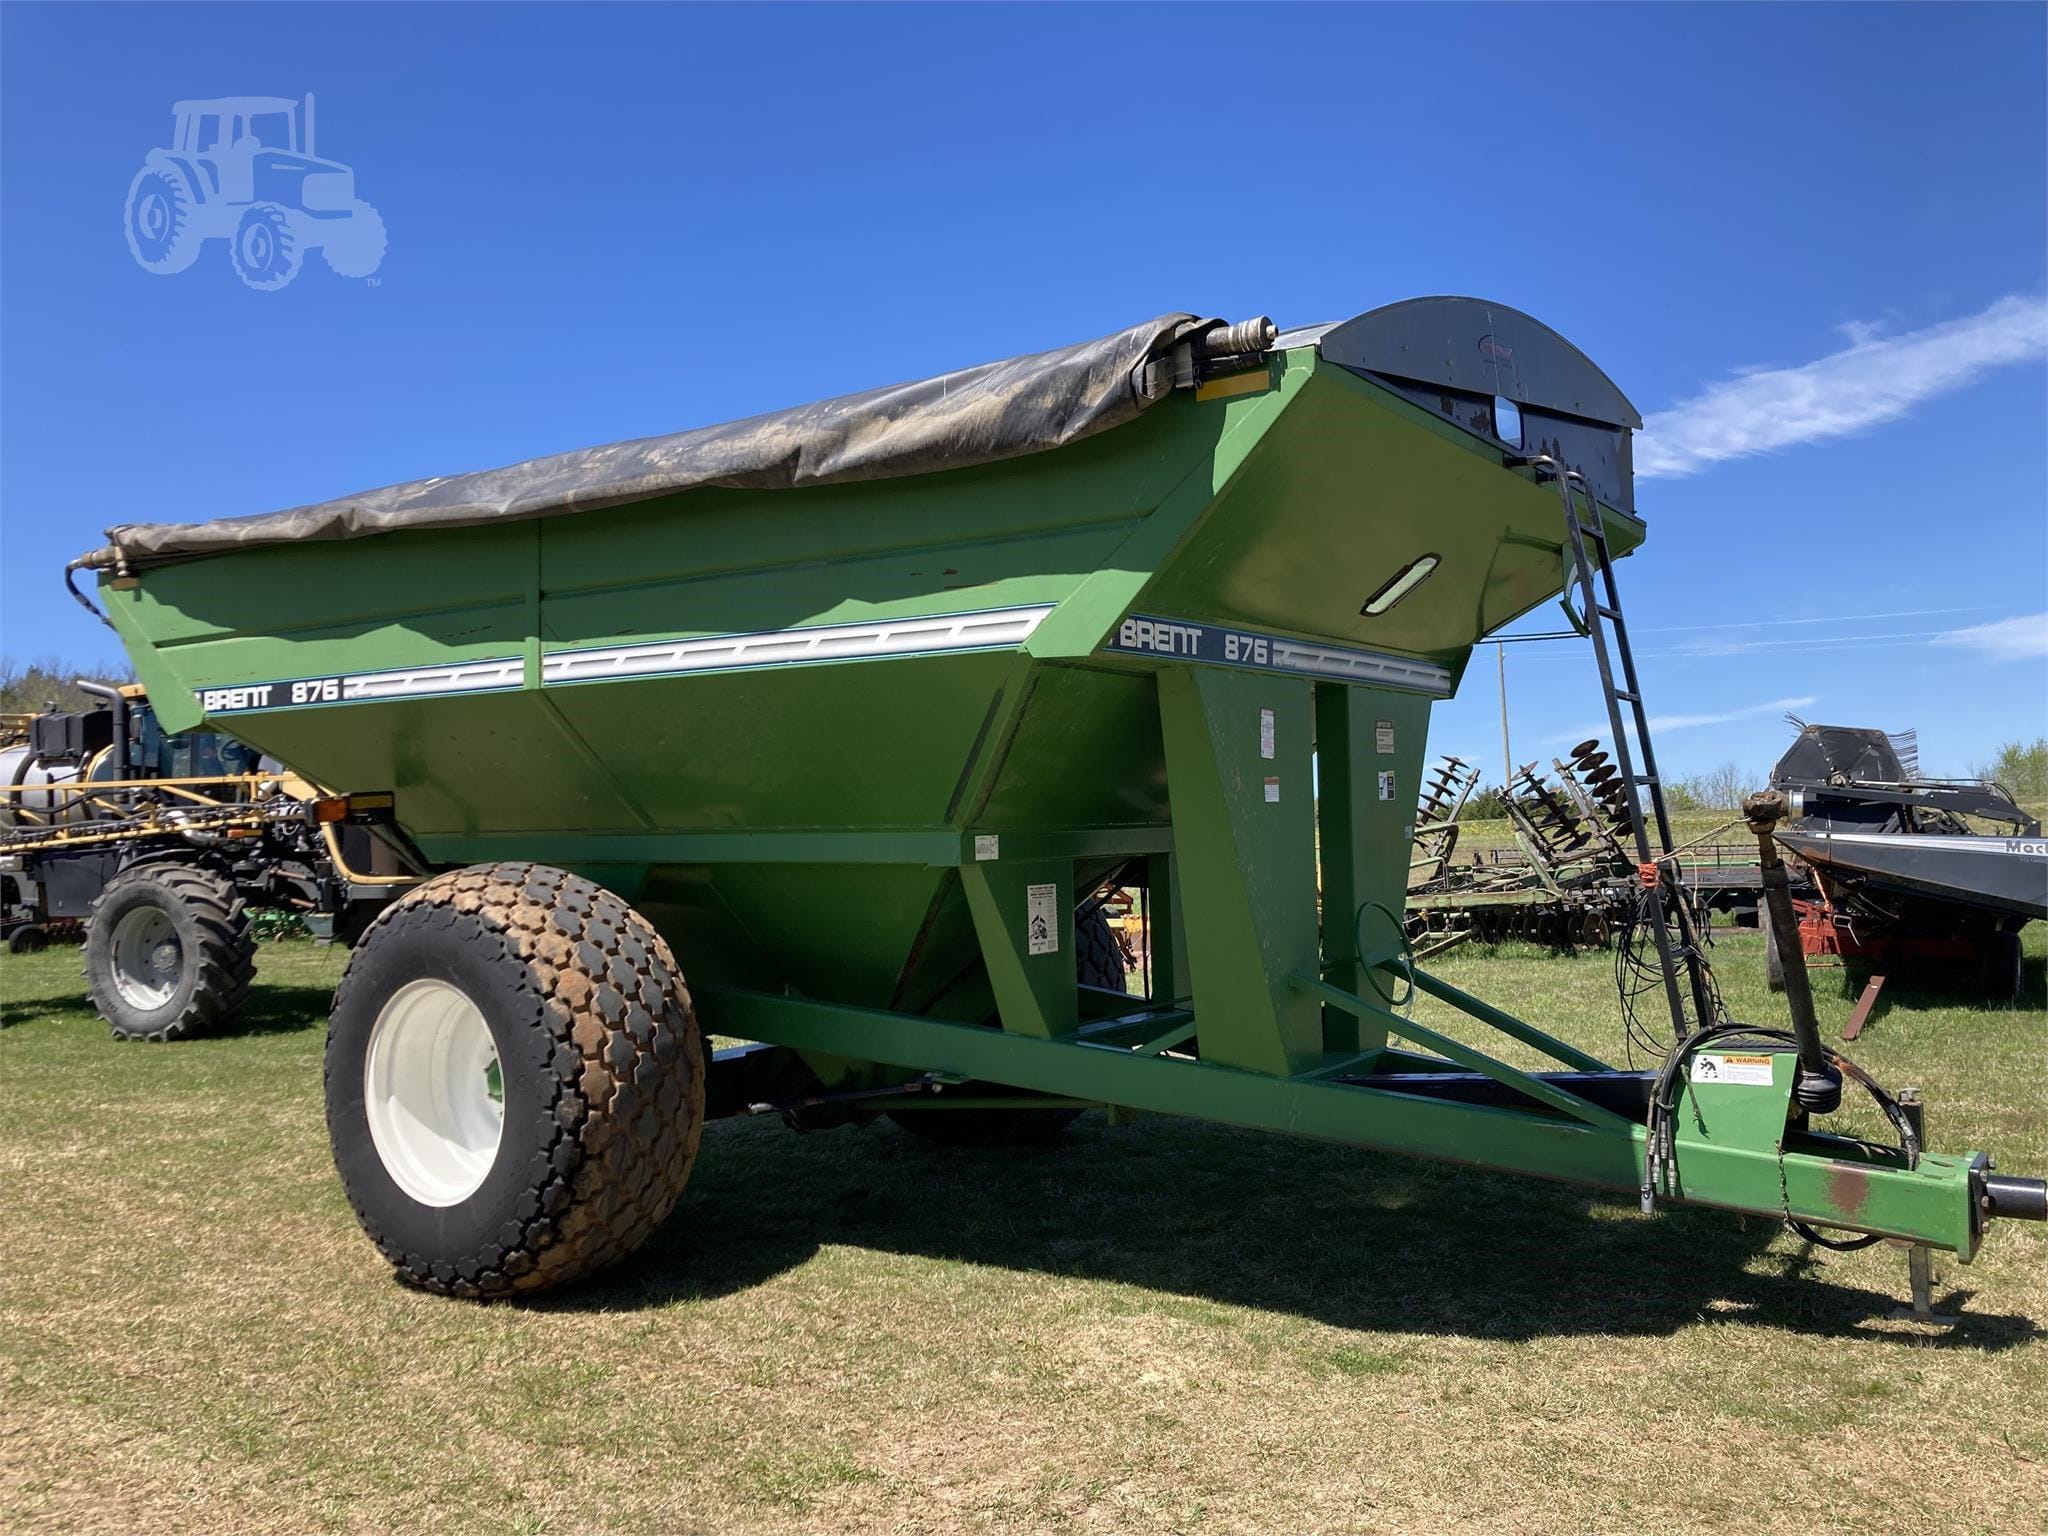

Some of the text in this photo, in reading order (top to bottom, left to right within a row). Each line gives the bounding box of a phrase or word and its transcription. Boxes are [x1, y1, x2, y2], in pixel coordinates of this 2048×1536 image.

[1119, 618, 1268, 665] BRENT 876
[203, 678, 339, 711] BRENT 876
[2005, 839, 2048, 854] Mac
[1735, 1057, 1770, 1065] WARNING
